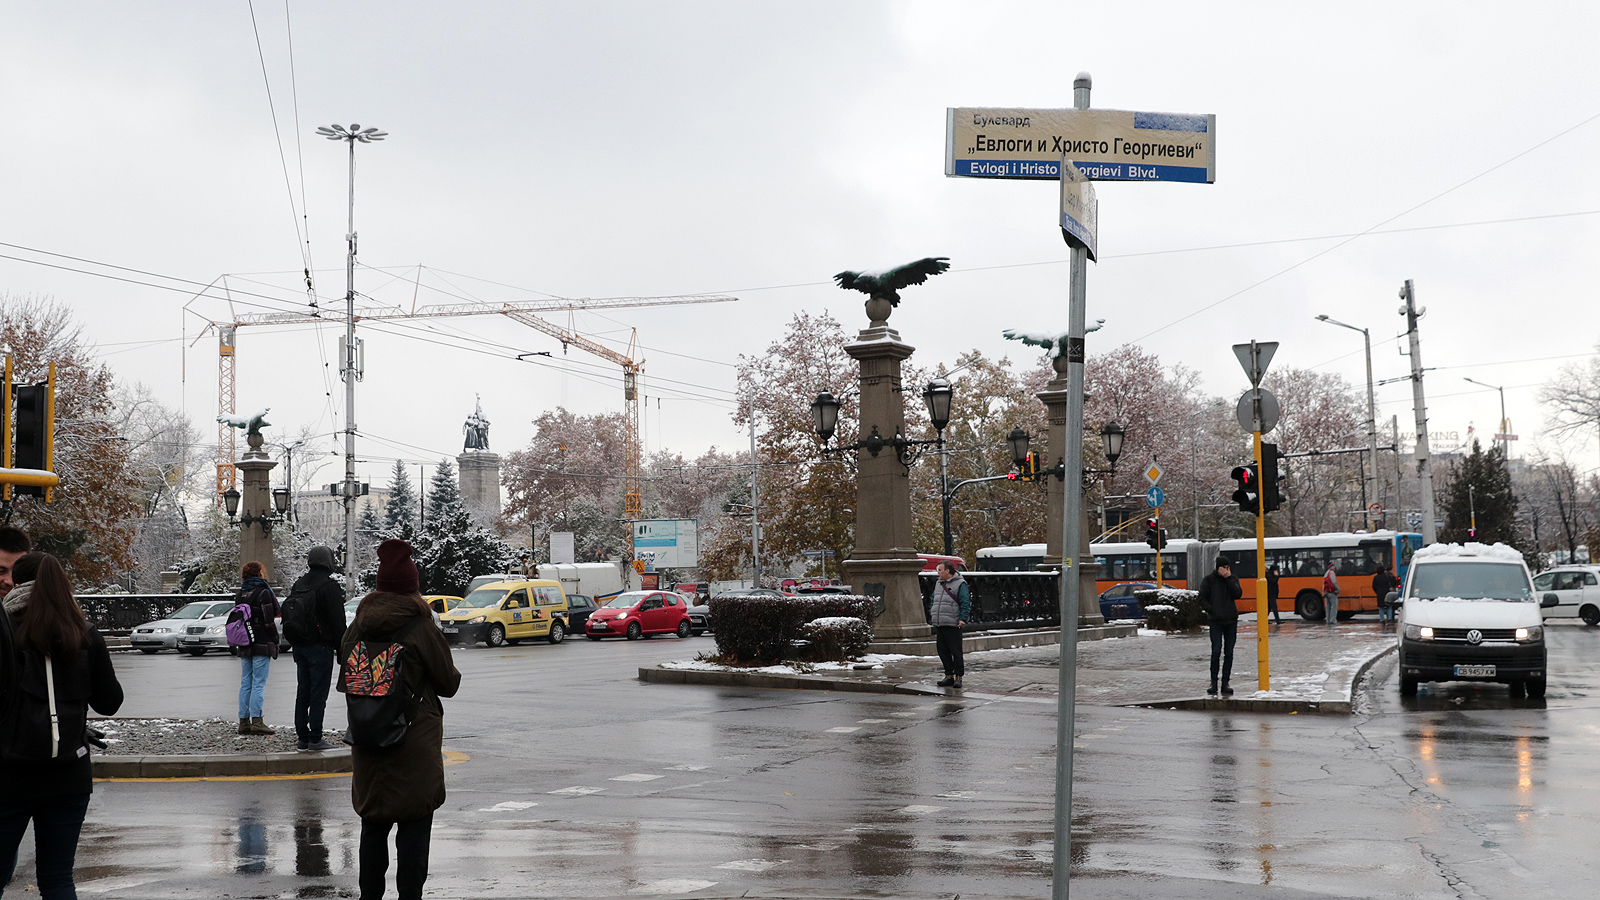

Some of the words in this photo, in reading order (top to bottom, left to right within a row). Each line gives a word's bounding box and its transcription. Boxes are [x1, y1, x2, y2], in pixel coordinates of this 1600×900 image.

[973, 114, 1031, 128] Булевард
[968, 134, 1032, 154] „Евлоги
[1037, 139, 1047, 152] и
[1051, 135, 1109, 157] Христо
[1113, 137, 1202, 160] Георгиеви“
[970, 161, 1009, 176] Evlogi
[1012, 162, 1016, 174] i
[1020, 162, 1058, 175] Hristo
[1079, 165, 1121, 178] orgievi
[1128, 166, 1159, 179] Blvd.
[1397, 431, 1459, 441] WAKING
